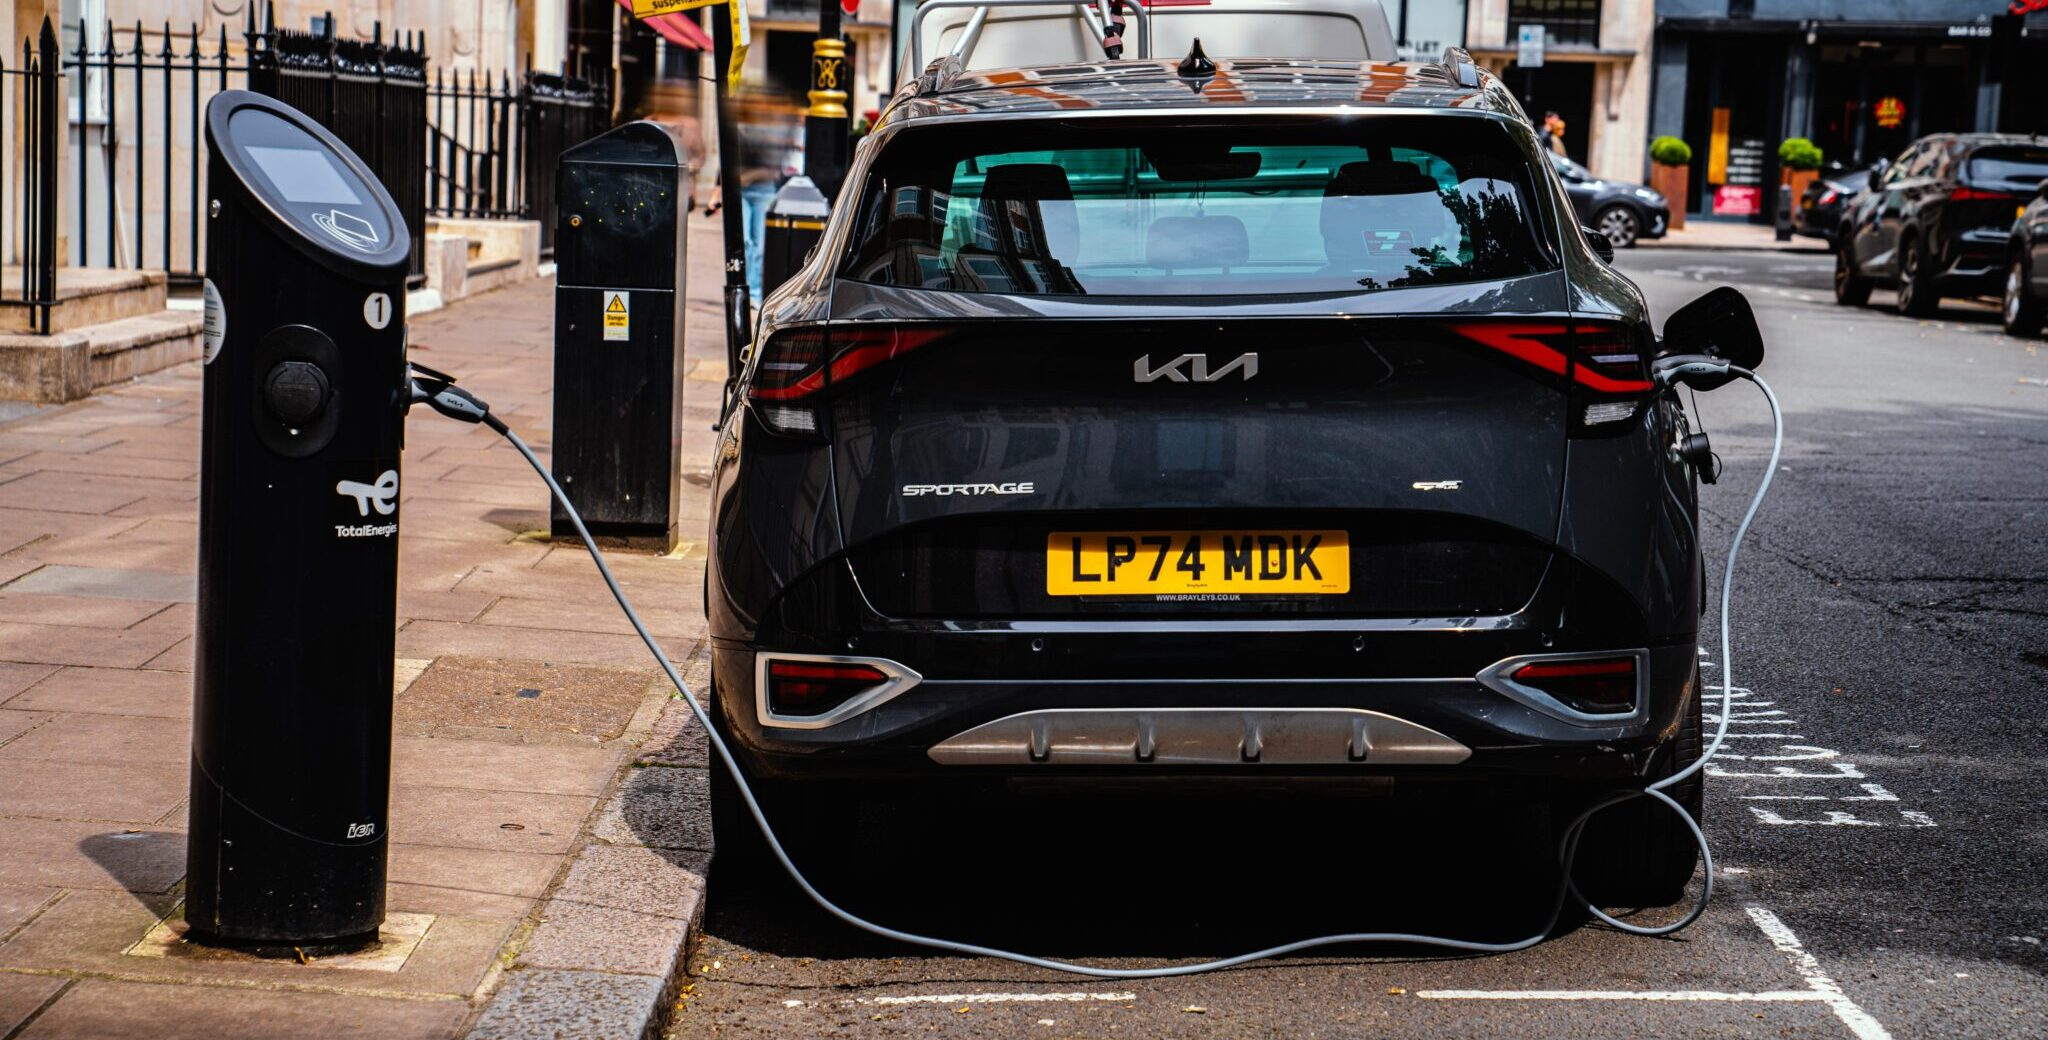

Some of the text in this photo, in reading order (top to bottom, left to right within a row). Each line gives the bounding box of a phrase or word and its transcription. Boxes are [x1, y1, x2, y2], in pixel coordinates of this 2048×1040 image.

[652, 0, 702, 9] suspen
[374, 296, 383, 323] 1
[606, 314, 626, 322] Danger
[1134, 352, 1258, 382] KIA
[902, 482, 1035, 497] SPORTAGE
[1072, 535, 1323, 582] LP74 MDK
